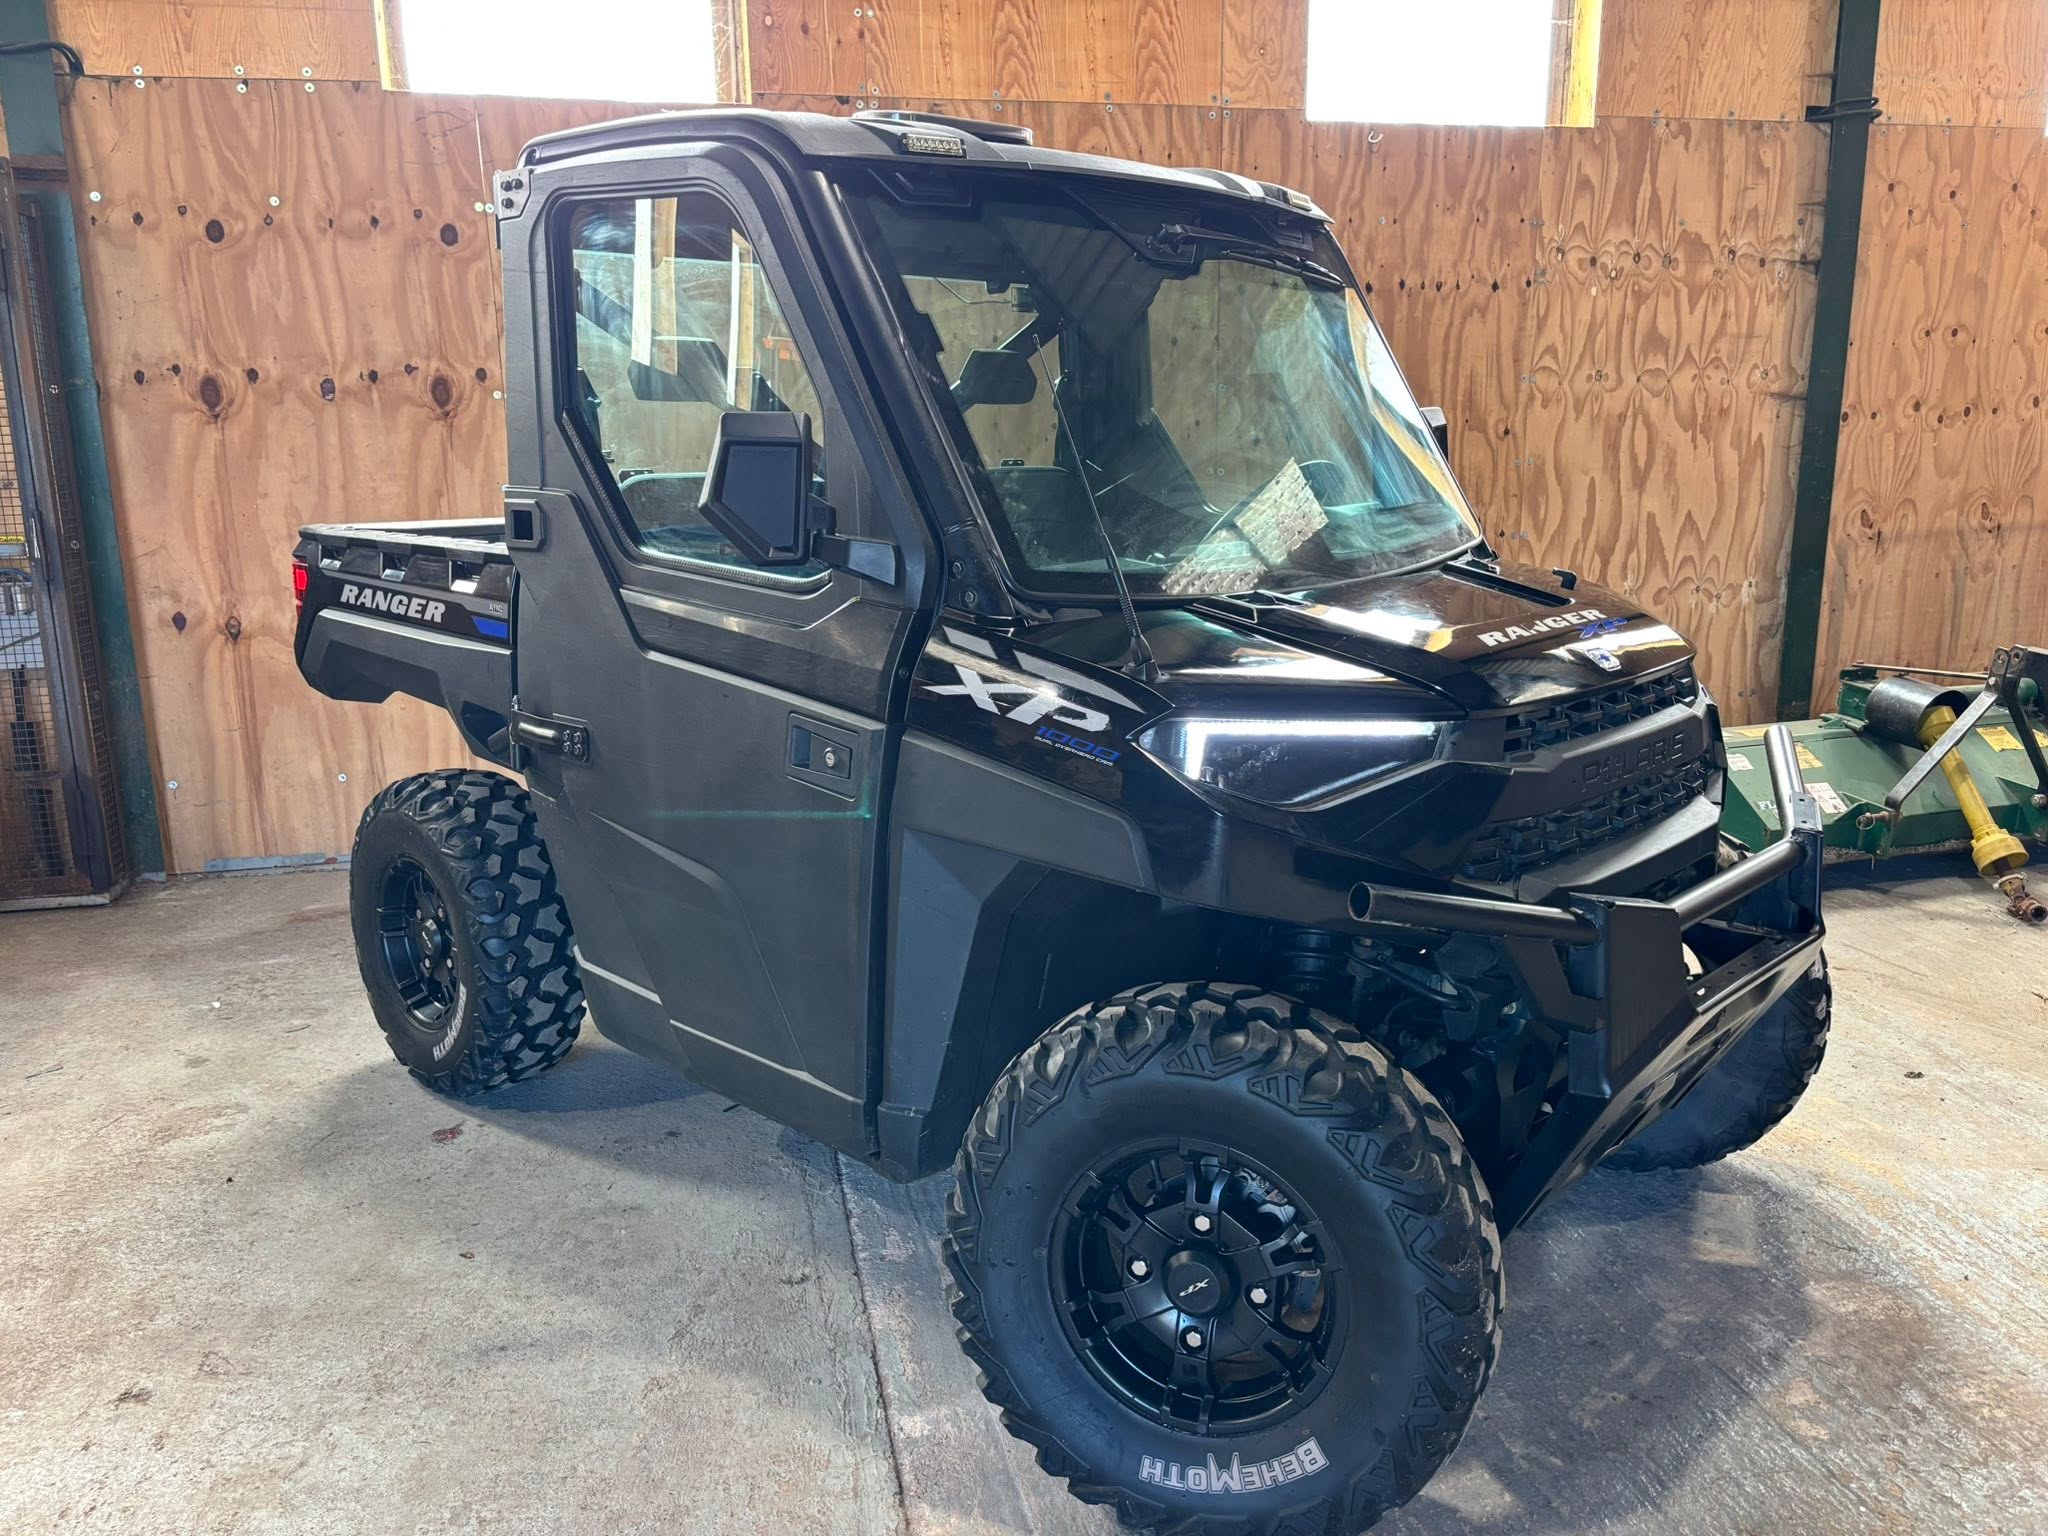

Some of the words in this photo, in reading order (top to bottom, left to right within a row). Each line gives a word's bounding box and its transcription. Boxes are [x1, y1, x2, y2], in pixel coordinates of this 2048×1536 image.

[340, 584, 446, 623] RANGER
[1477, 608, 1608, 648] RANGER
[920, 663, 1113, 733] XP
[1033, 735, 1055, 747] DUAL
[1054, 743, 1097, 761] OVERHEAD
[1036, 726, 1121, 762] 1000
[1581, 732, 1685, 794] POLARIS
[1138, 1436, 1330, 1494] BEHEMOTH
